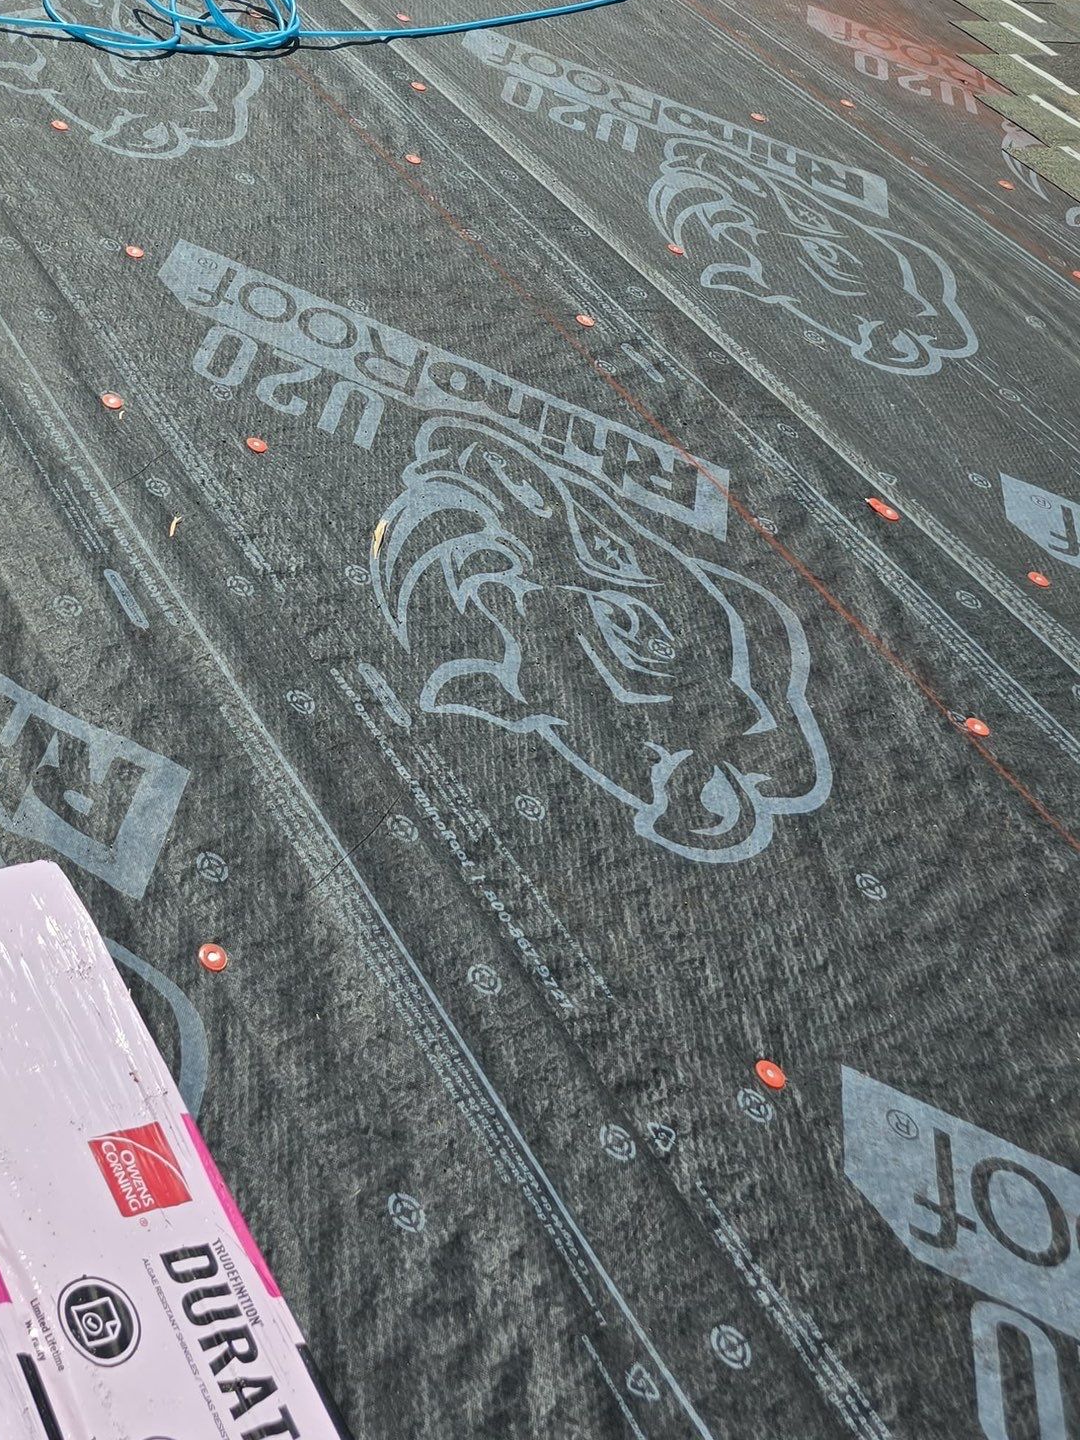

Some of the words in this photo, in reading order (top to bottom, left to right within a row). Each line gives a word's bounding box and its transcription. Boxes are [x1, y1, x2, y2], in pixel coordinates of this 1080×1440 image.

[498, 75, 639, 154] U20
[853, 67, 981, 114] U20
[191, 324, 387, 451] U20
[482, 886, 574, 1014] 800-567-9727
[100, 1137, 141, 1215] CORNING
[118, 1146, 154, 1210] OWENS
[211, 1236, 264, 1329] TRUDEFINITION
[29, 1296, 50, 1333] Limited
[43, 1332, 66, 1372] Lifetime
[140, 1257, 158, 1286] ALGAE
[153, 1285, 180, 1331] RESISTANT
[174, 1332, 200, 1376] SHINGLES
[196, 1381, 216, 1411] TEJAS
